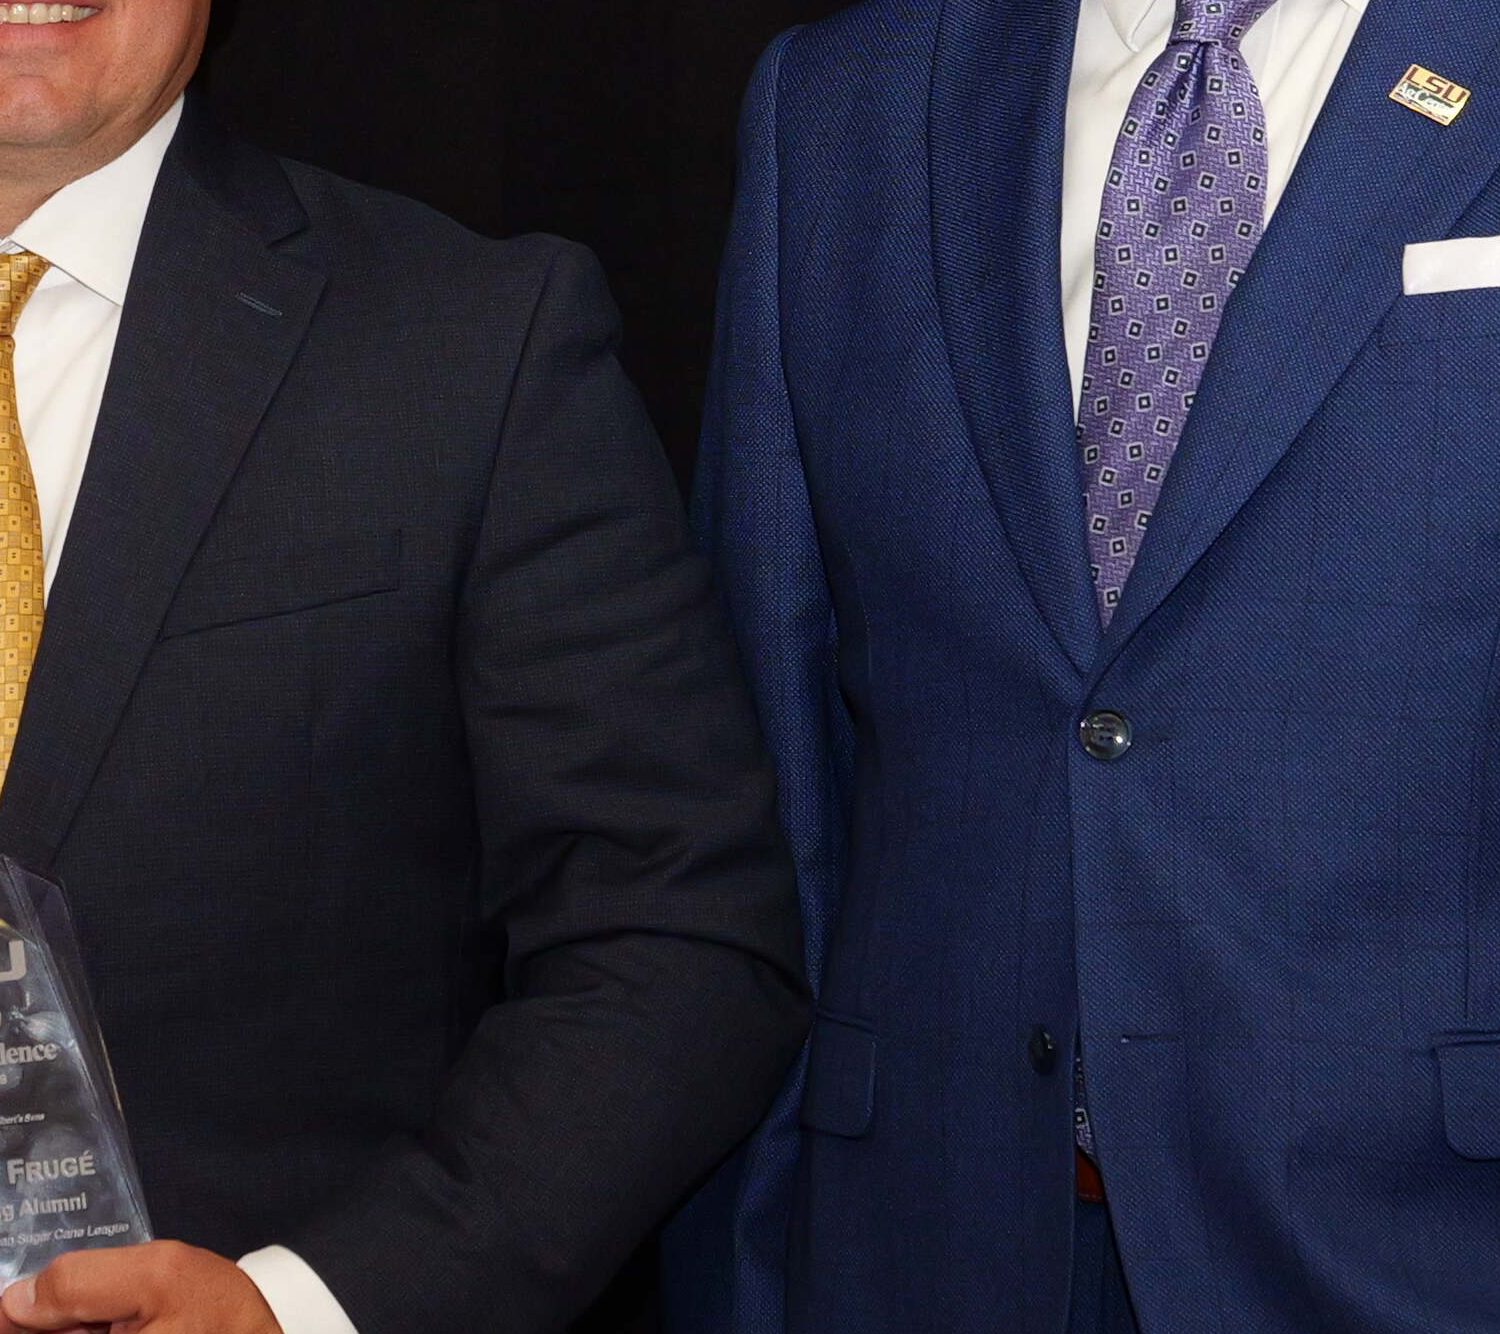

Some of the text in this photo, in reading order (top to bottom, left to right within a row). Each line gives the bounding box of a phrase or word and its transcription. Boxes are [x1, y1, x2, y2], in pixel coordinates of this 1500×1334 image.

[1406, 67, 1467, 103] LSU
[6, 1150, 96, 1185] FRUGÉ
[19, 1192, 88, 1216] Alumni
[17, 1231, 52, 1246] Sugar
[54, 1226, 85, 1241] Cane
[86, 1222, 130, 1238] League
